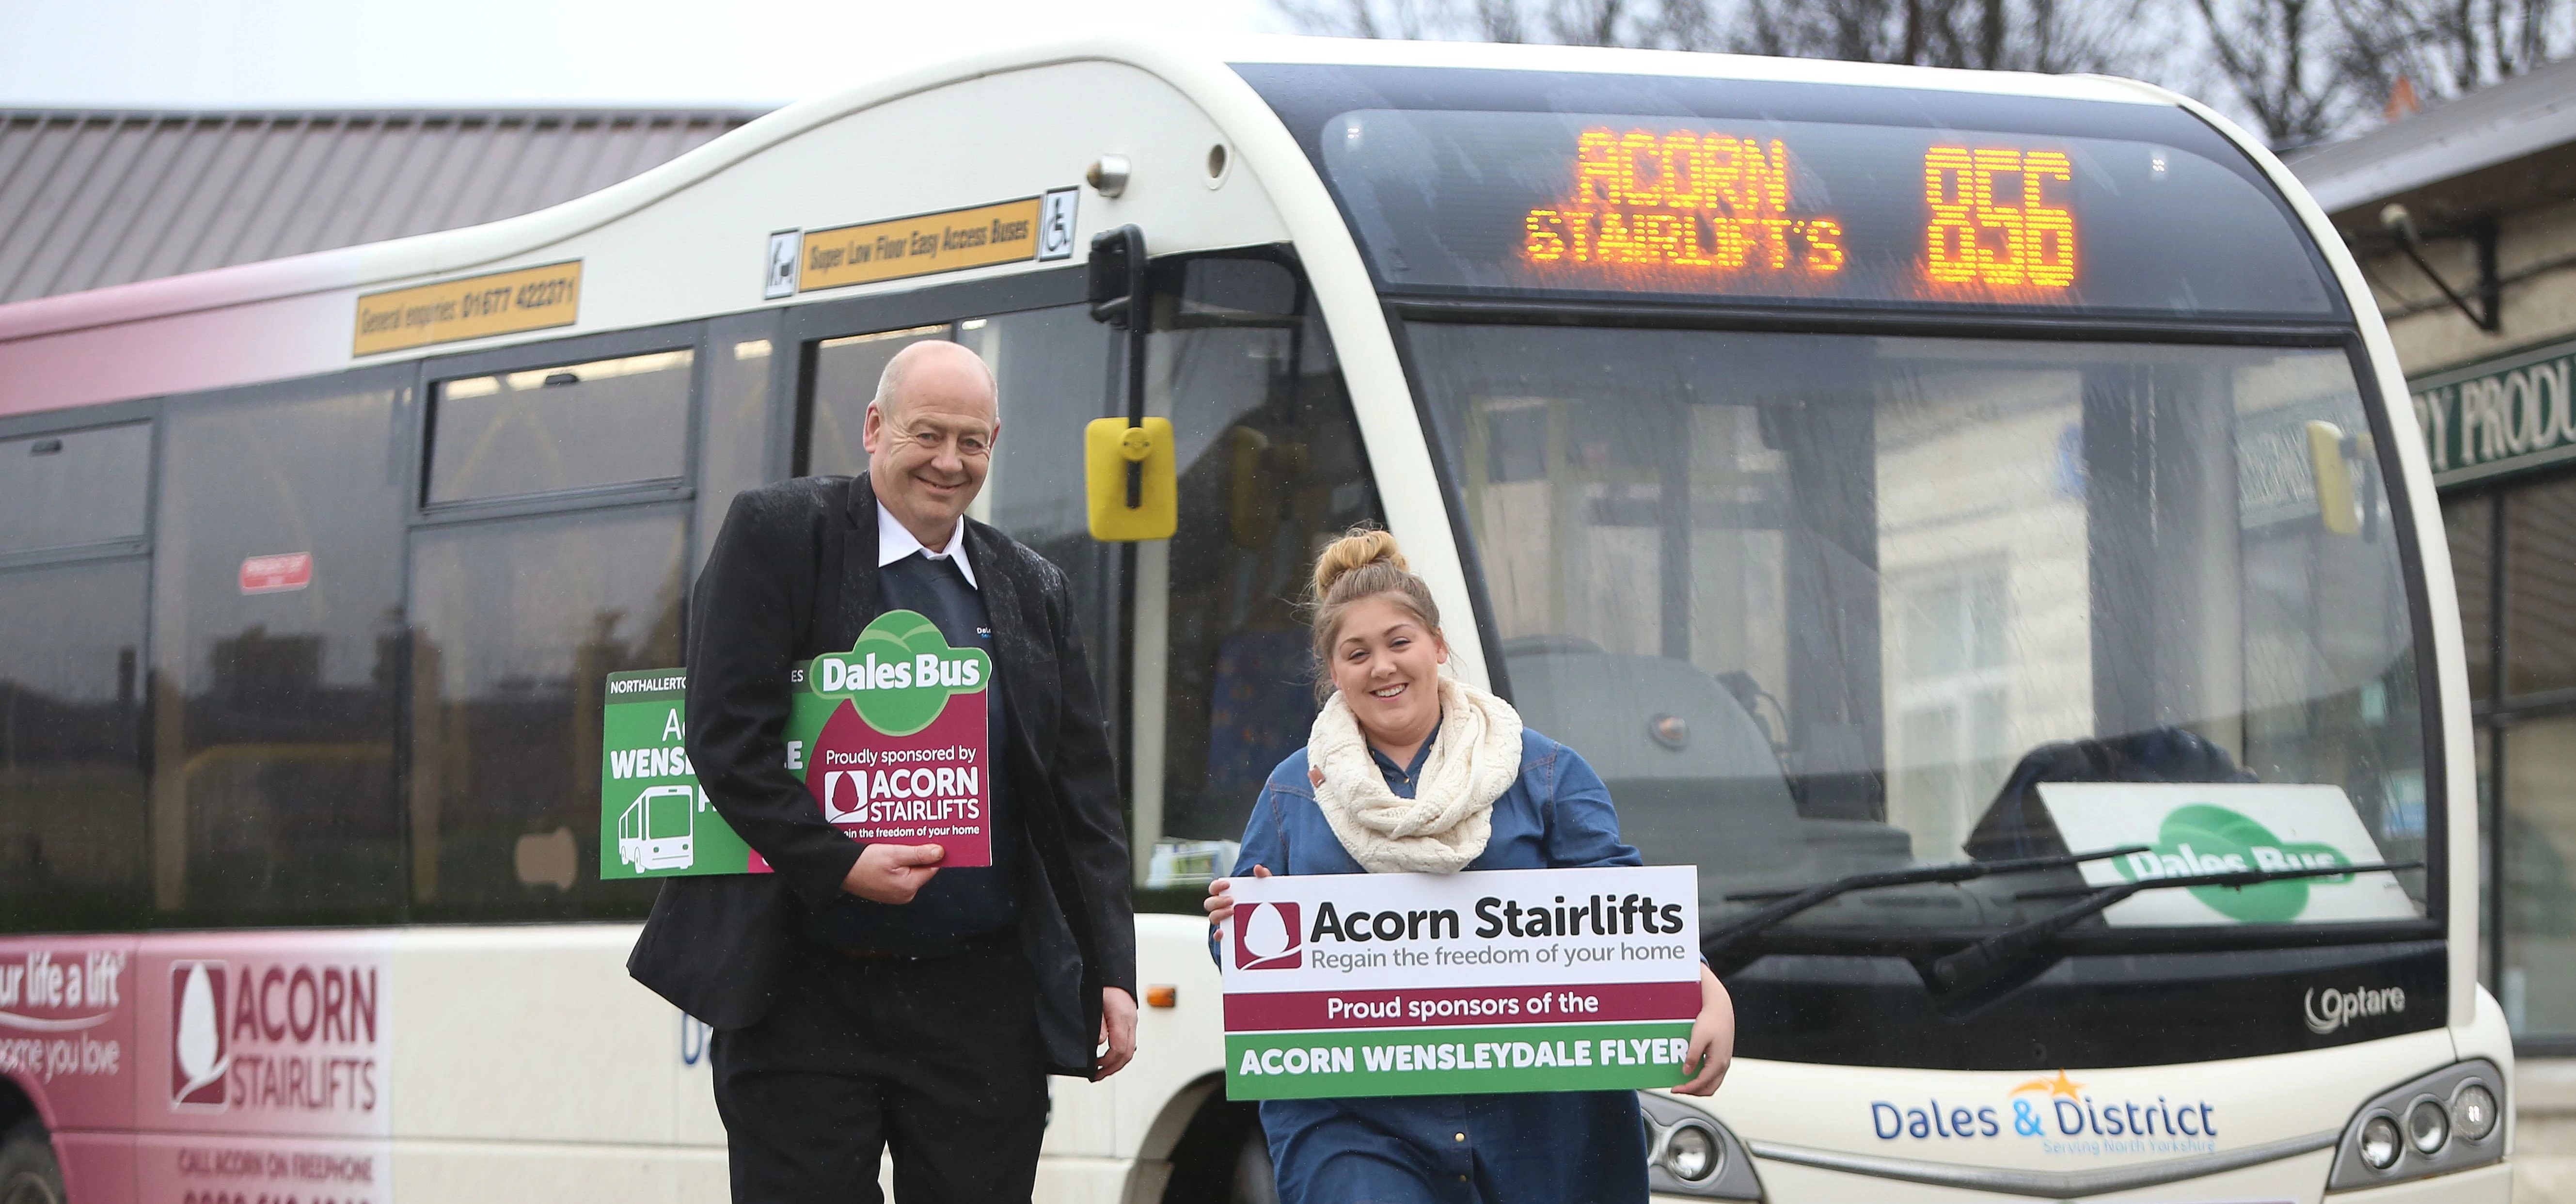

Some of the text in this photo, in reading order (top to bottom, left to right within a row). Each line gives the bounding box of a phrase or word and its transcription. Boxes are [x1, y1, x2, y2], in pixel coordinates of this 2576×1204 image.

[1578, 128, 1788, 212] ACORN
[1925, 146, 2074, 287] 856
[809, 218, 1029, 273] Super Low Floor Easy Access Buses
[1526, 208, 1843, 271] STAIRLIFT'S
[822, 652, 980, 692] Dales Bus
[826, 745, 977, 767] Proudly sponsored by
[870, 766, 980, 799] ACORN
[859, 828, 874, 838] the
[876, 826, 915, 838] freedom
[917, 825, 927, 837] of
[928, 827, 951, 839] your
[952, 824, 980, 835] home
[870, 798, 980, 823] STAIRLIFTS
[1310, 893, 1683, 943] Acorn Stairlifts
[1312, 942, 1685, 973] Regain the freedom of your home
[27, 951, 64, 1009] life
[66, 963, 82, 1008] a
[232, 966, 378, 1043] ACORN
[1328, 991, 1598, 1022] Proud sponsors of the
[2318, 986, 2406, 1028] Optare
[44, 1039, 80, 1084] you
[81, 1030, 121, 1076] love
[1239, 1038, 1689, 1075] ACORN WENSLEYDALE FLYER
[231, 1055, 377, 1113] STAIRLIFTS
[1871, 1095, 2218, 1140] Dales & District
[2043, 1137, 2216, 1156] Serving North Yorkshire
